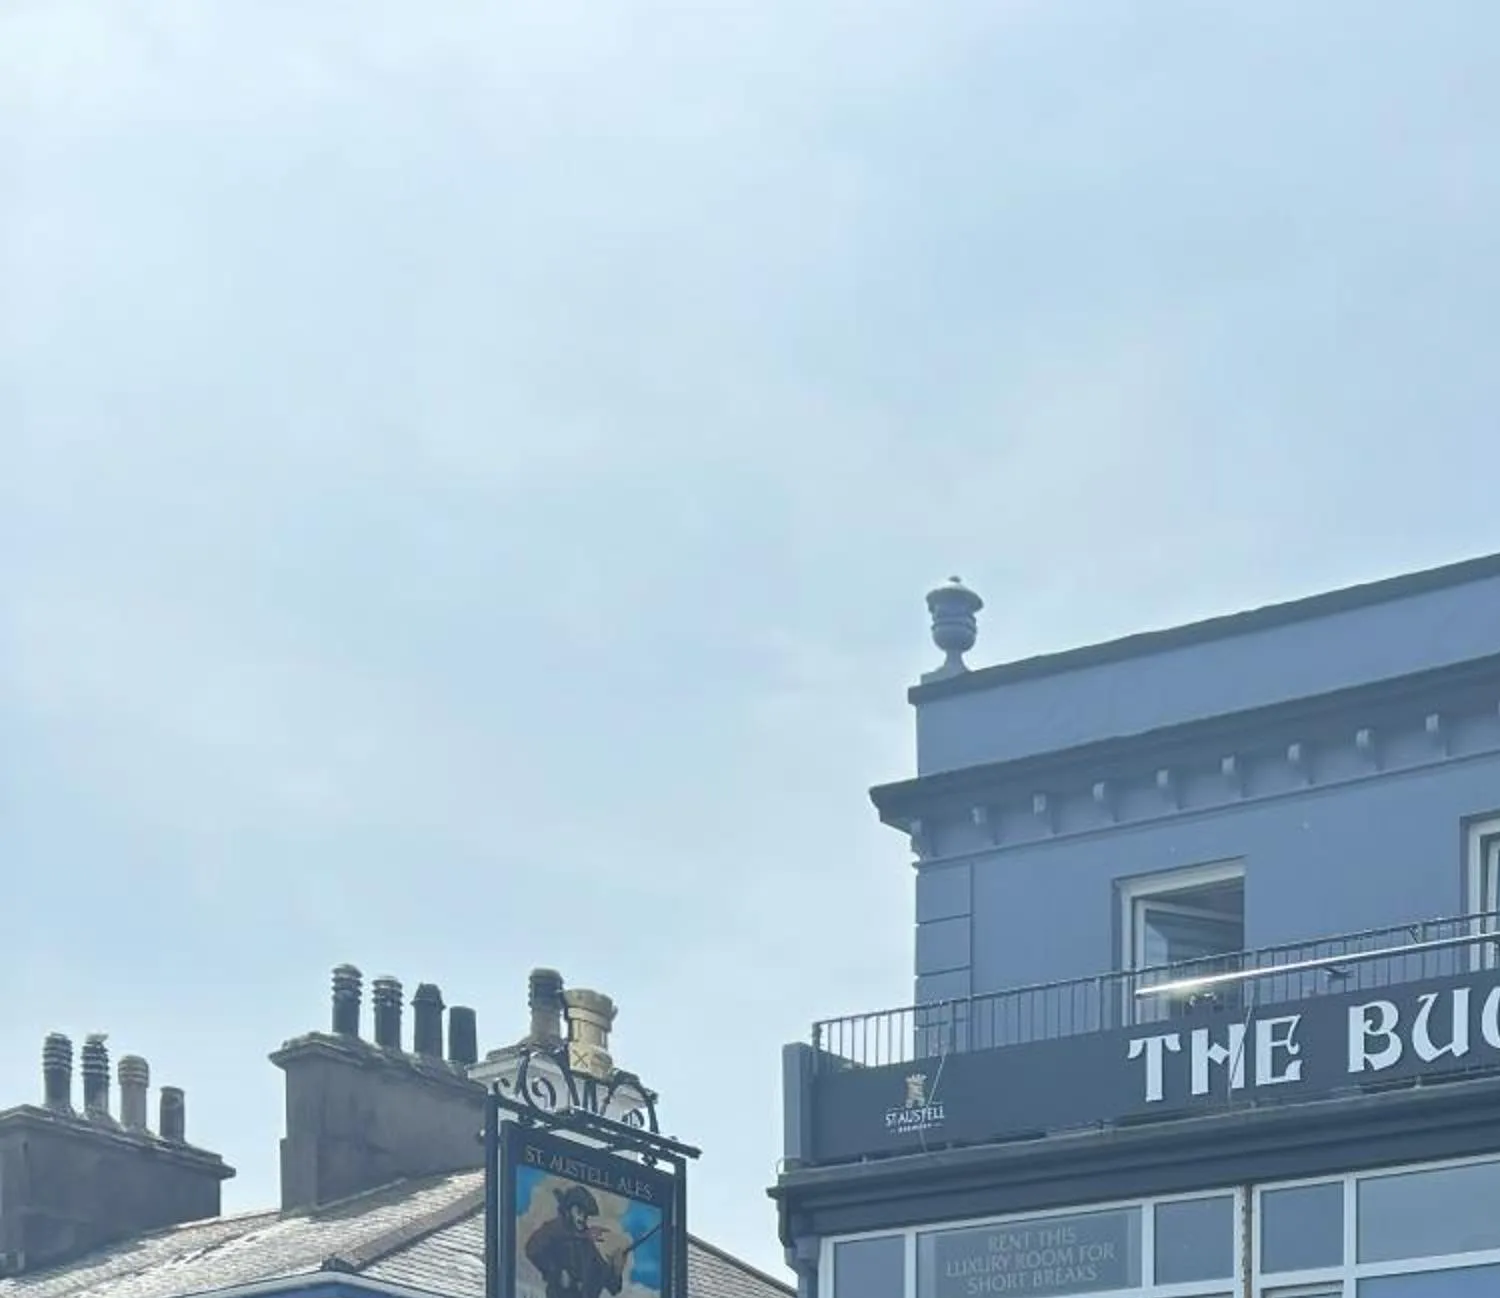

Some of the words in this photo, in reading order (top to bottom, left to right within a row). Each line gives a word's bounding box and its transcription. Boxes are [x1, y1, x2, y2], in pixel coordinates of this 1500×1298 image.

[1128, 1013, 1303, 1101] THE
[988, 1230, 1033, 1253] RENT
[1038, 1225, 1077, 1247] THIS
[946, 1253, 1011, 1278] LUXURY
[1013, 1246, 1074, 1272] ROOM
[1075, 1240, 1118, 1264] FOR
[966, 1270, 1026, 1296] SHORT
[1032, 1263, 1098, 1288] BREAKS
